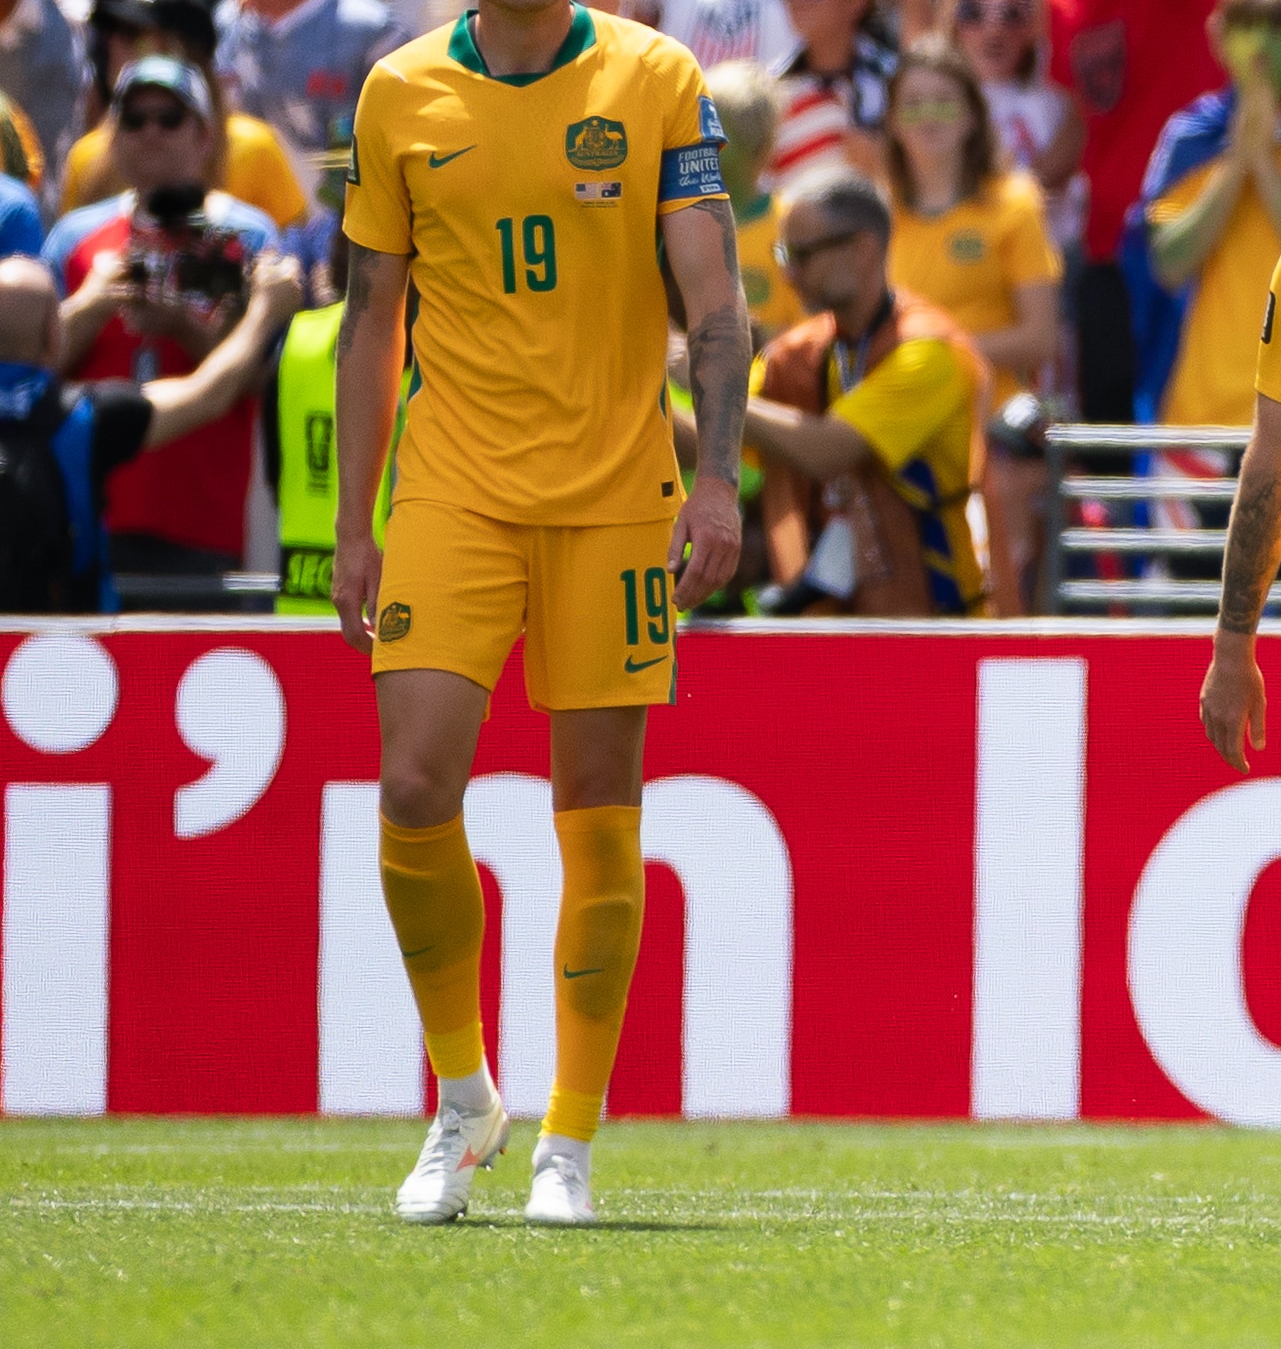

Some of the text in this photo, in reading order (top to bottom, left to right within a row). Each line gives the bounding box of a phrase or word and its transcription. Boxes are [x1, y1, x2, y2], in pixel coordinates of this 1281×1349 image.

[495, 214, 557, 294] 19
[286, 553, 333, 596] SEC
[620, 566, 670, 646] 19
[0, 634, 793, 1120] i’m
